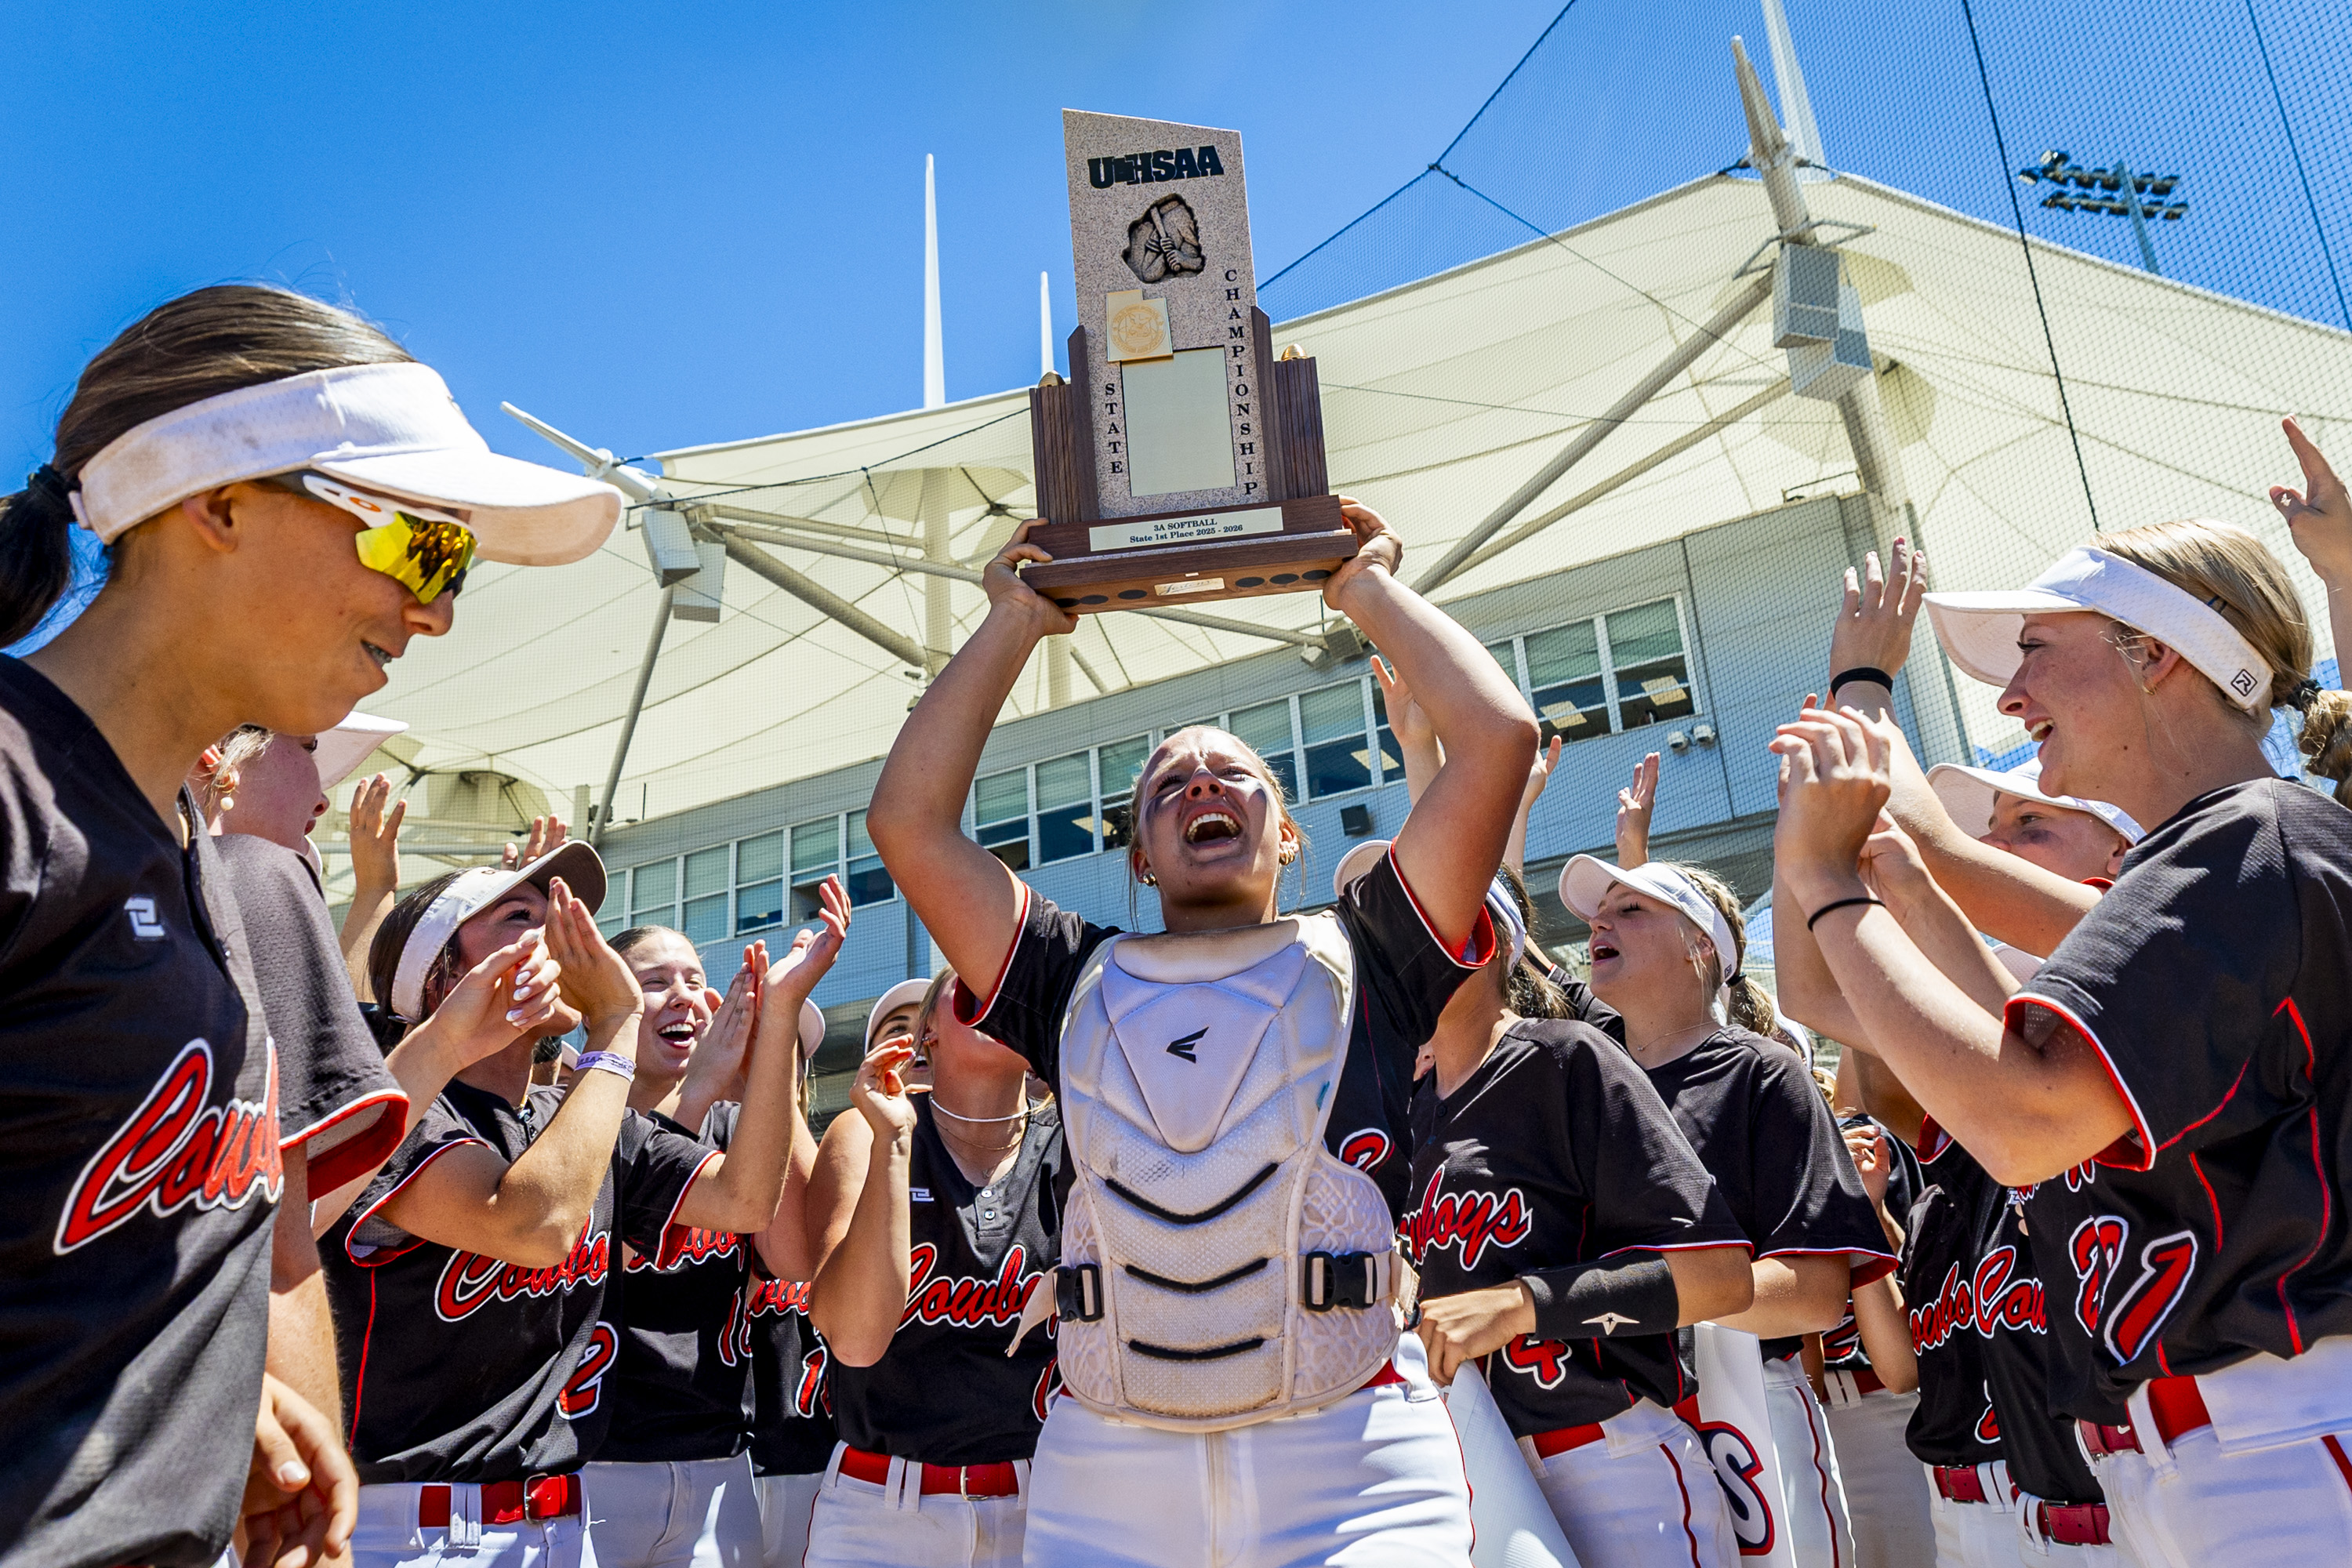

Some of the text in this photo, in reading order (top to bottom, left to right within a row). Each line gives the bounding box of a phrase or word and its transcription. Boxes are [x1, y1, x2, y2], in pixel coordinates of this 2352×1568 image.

[1225, 269, 1258, 495] CHAMPIONSHIP
[1105, 383, 1123, 474] STATE
[1130, 533, 1153, 543] State
[1155, 532, 1168, 541] 1st
[1170, 529, 1195, 539] Place
[1196, 528, 1216, 537] 2025
[1223, 524, 1243, 533] 2026
[1167, 518, 1218, 531] SOFTBALL
[556, 1321, 619, 1421] 2
